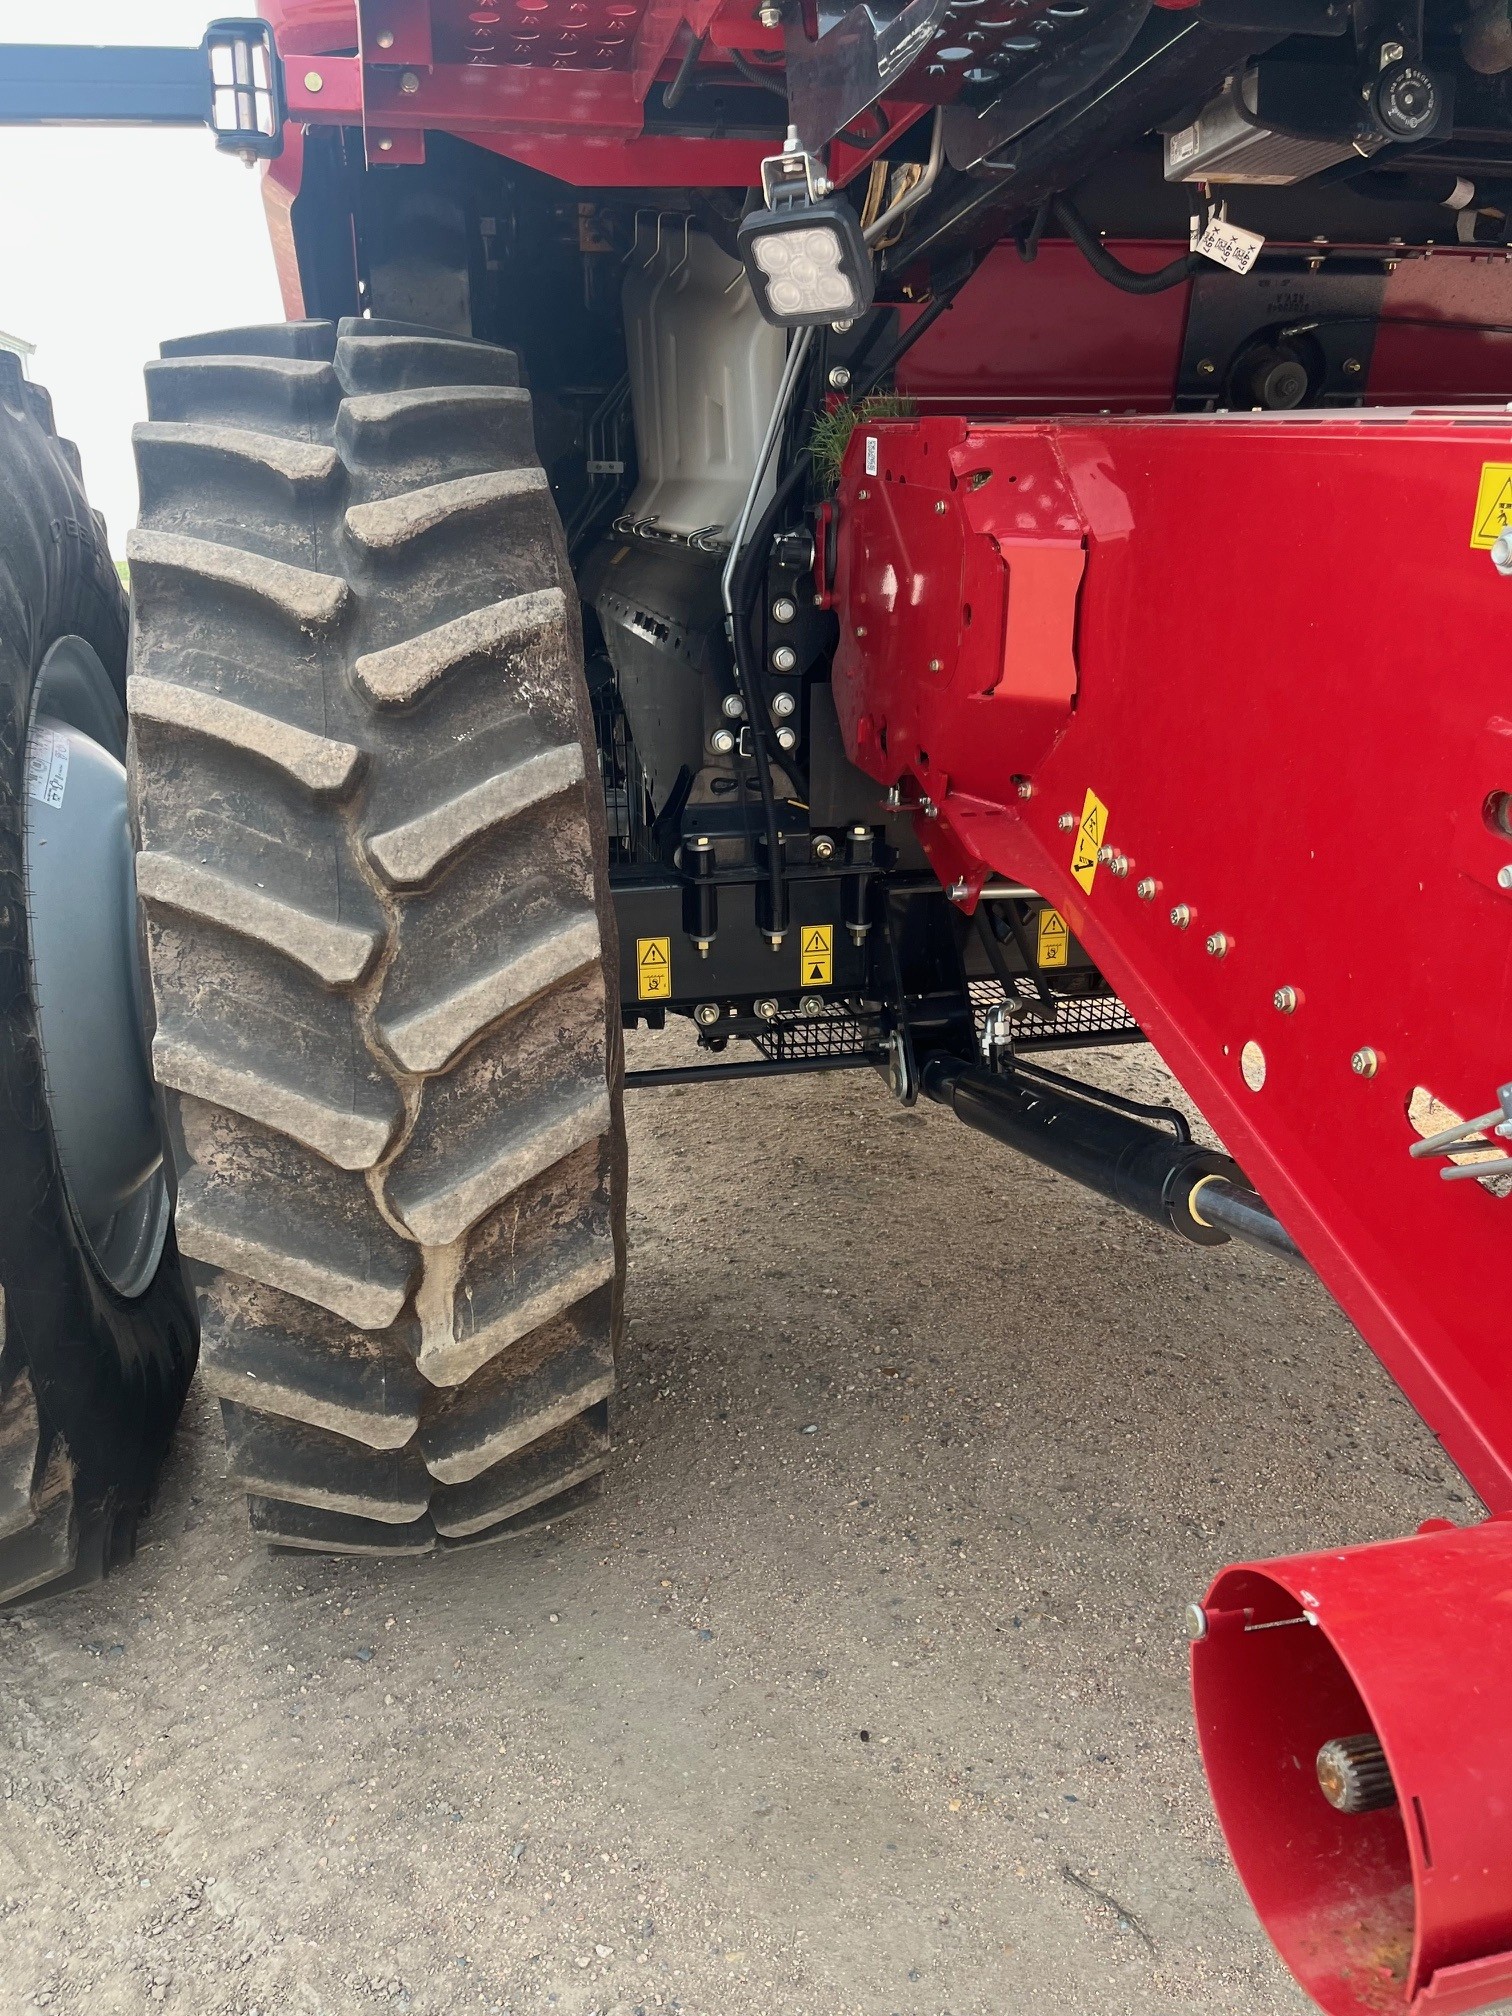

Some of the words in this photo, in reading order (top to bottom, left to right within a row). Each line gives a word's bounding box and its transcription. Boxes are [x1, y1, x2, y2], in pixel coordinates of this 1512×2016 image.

[1203, 226, 1221, 253] X-497
[1221, 235, 1239, 263] X-497
[1238, 244, 1256, 271] X-497
